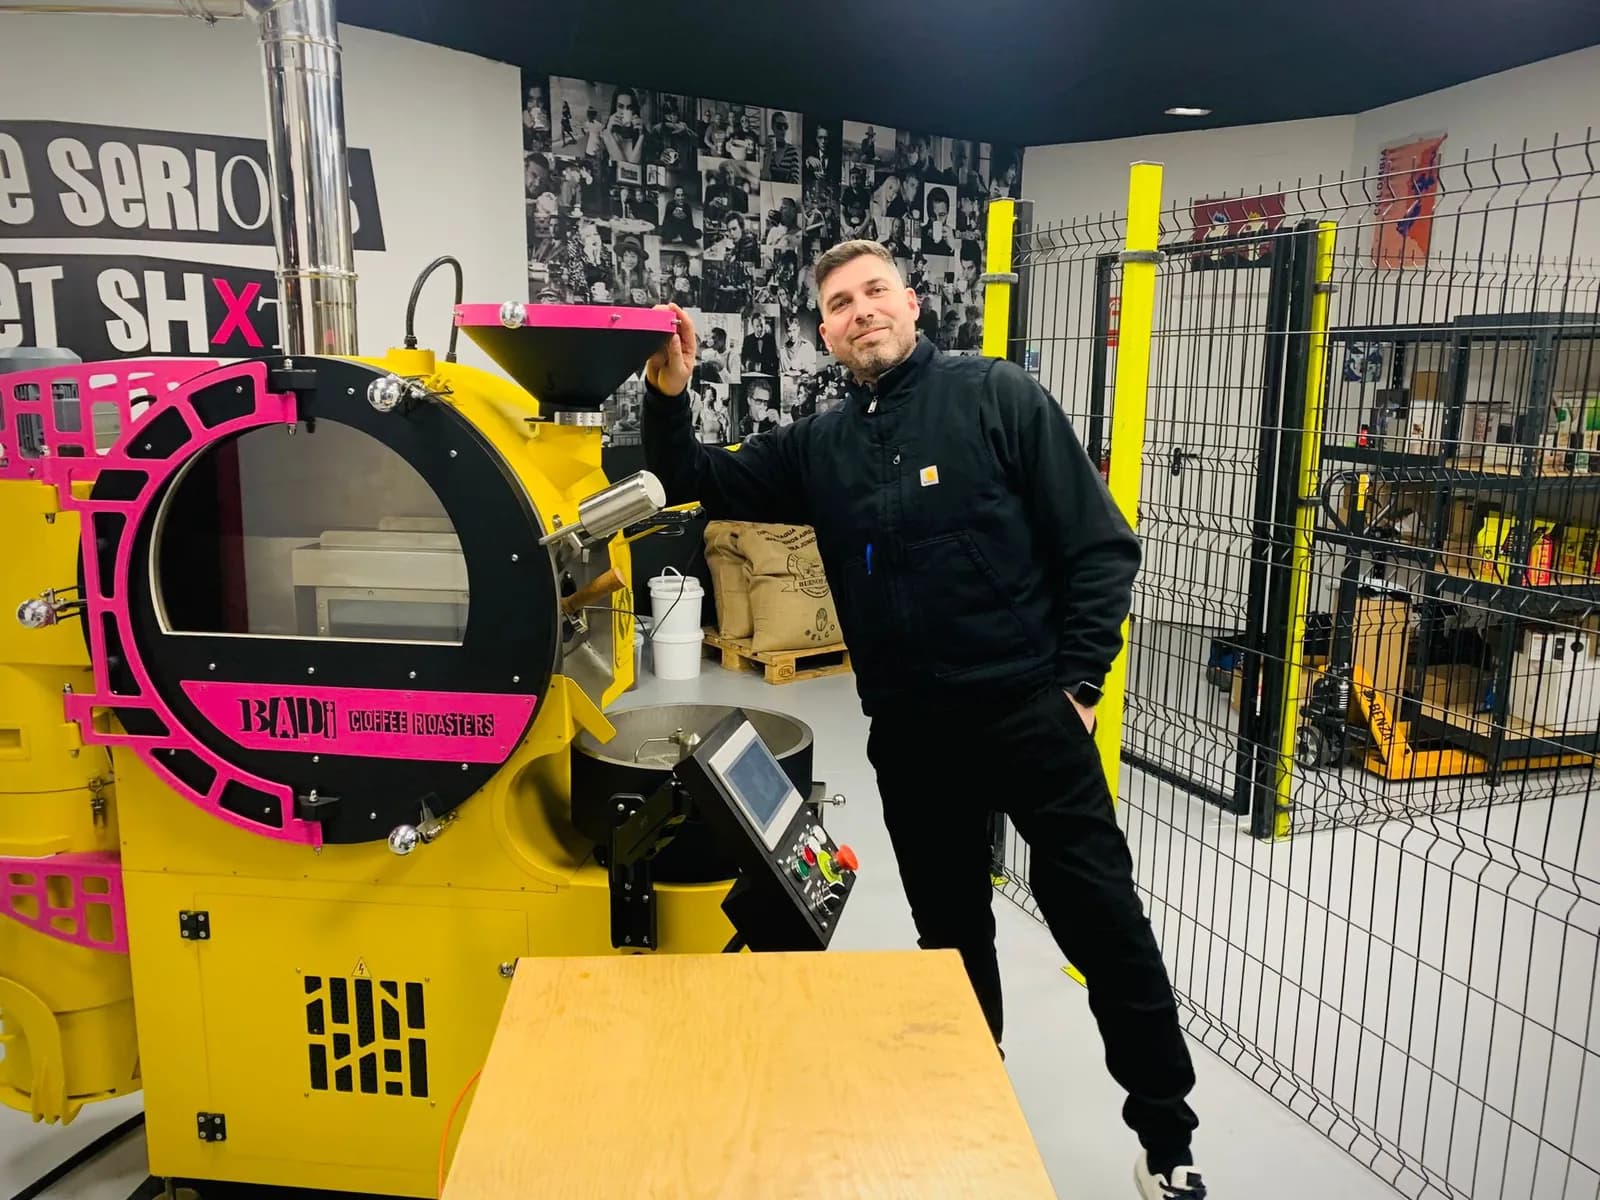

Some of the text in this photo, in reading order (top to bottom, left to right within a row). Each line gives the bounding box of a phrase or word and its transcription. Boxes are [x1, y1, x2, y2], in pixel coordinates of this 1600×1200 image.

[1373, 149, 1387, 216] COLOMBIA
[348, 710, 408, 733] COFFEE
[412, 712, 495, 737] ROASTERS
